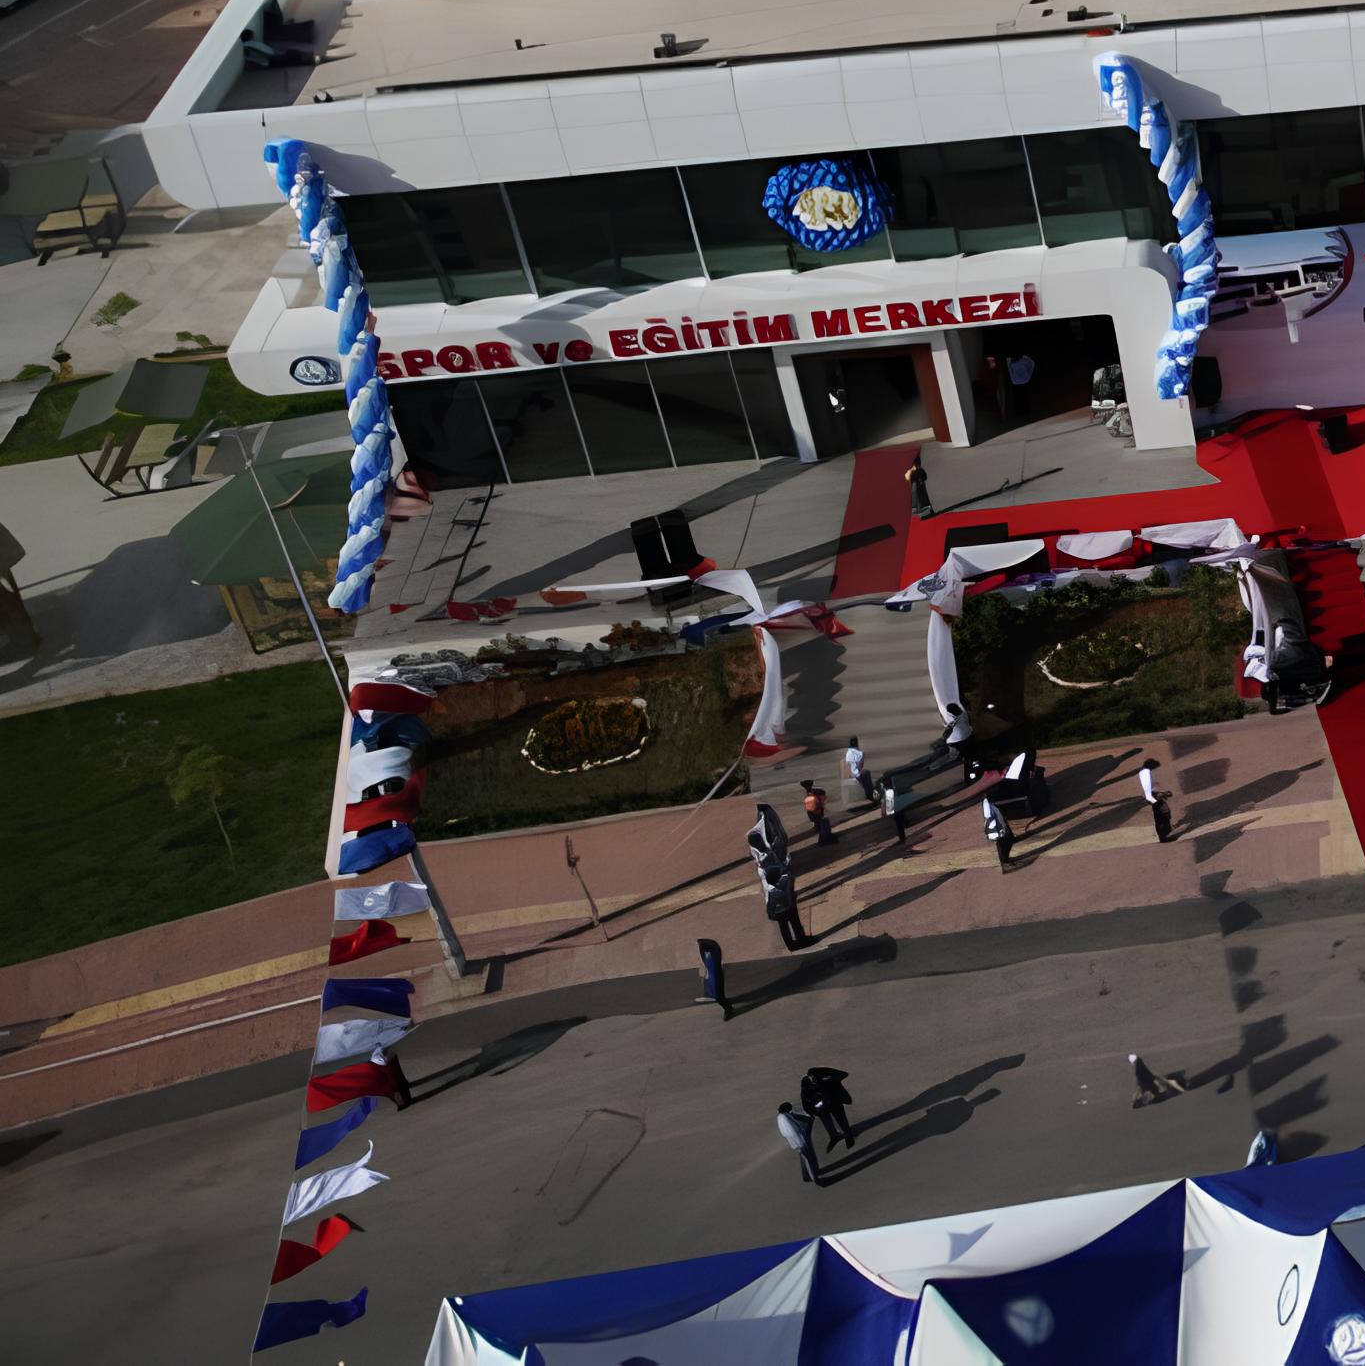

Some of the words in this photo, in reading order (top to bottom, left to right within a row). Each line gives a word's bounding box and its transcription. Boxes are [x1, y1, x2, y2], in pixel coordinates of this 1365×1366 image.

[376, 340, 522, 379] SPOR
[608, 310, 801, 359] EĞİTİM
[810, 282, 1043, 339] MERKEZİ
